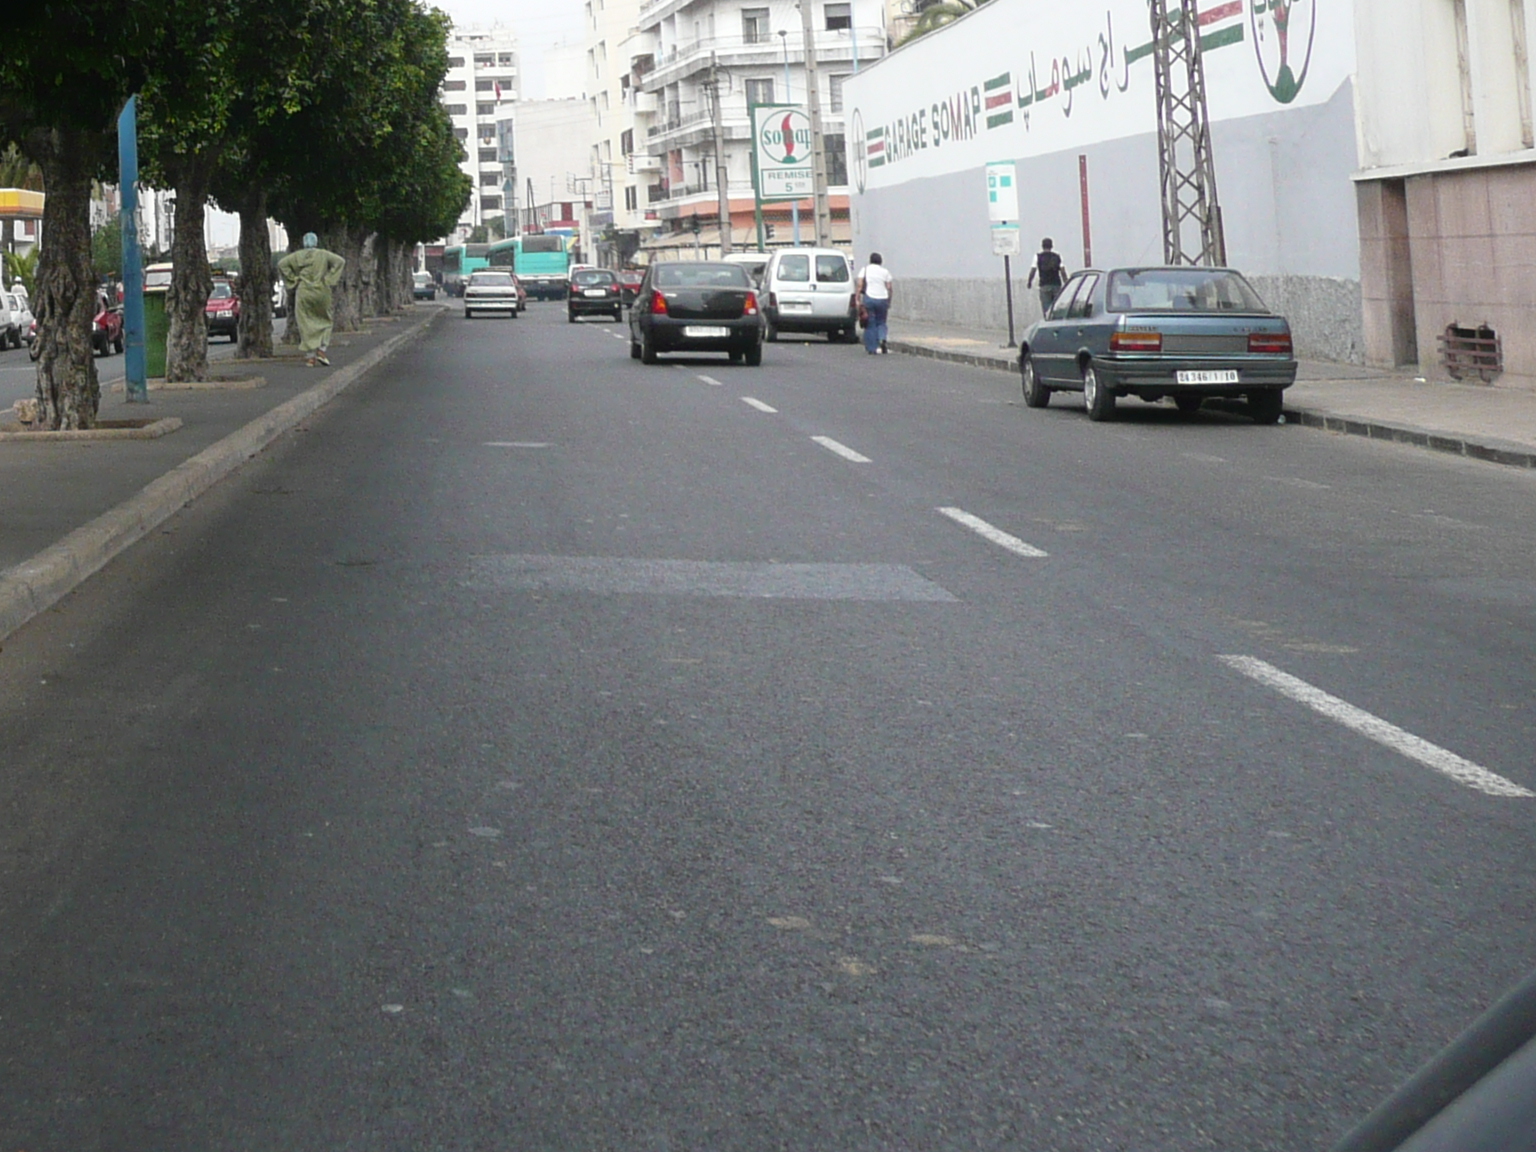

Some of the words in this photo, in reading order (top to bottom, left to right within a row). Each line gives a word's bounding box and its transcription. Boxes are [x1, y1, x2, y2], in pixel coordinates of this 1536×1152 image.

[884, 108, 928, 164] GARAGE
[931, 86, 981, 148] SOMAP
[768, 170, 814, 180] REMISE
[785, 182, 794, 193] 5
